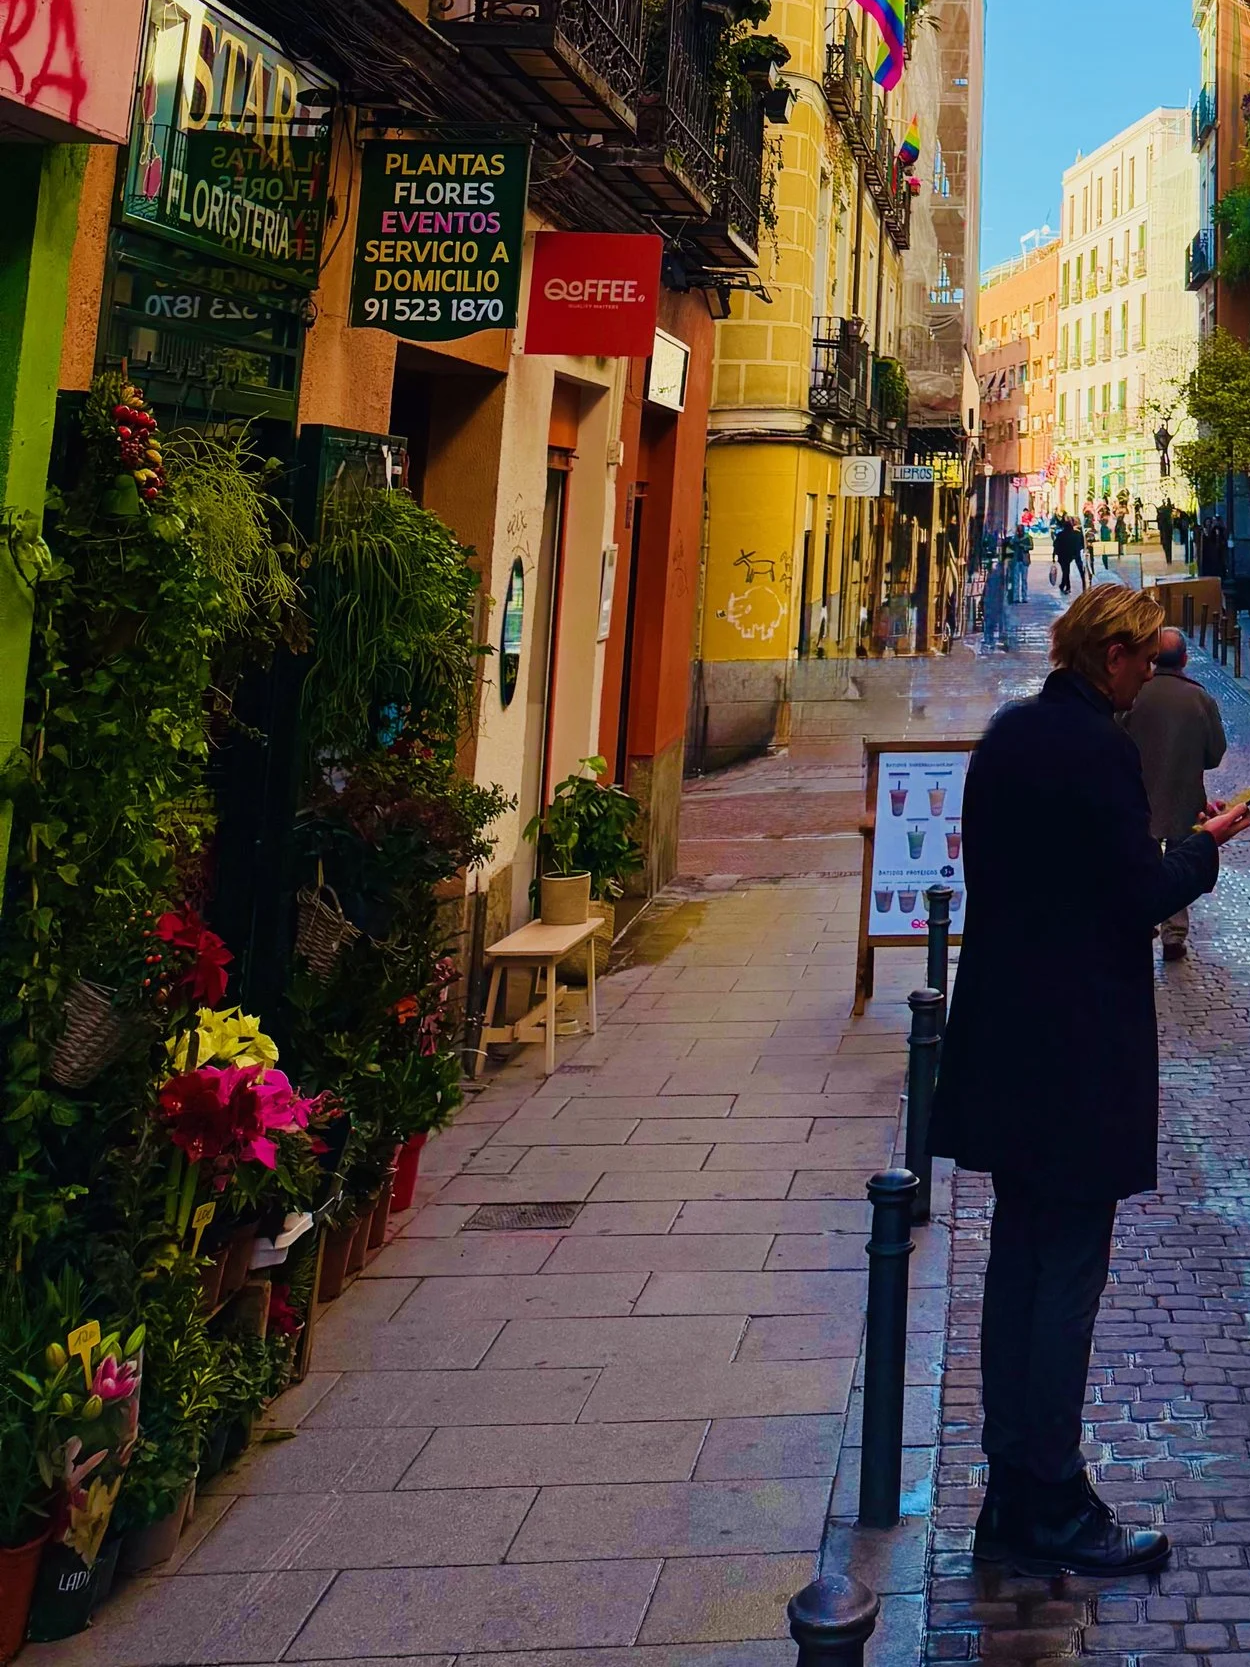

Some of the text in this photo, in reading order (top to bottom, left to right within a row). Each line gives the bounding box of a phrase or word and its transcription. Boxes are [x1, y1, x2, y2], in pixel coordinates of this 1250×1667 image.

[181, 21, 298, 171] STAR
[385, 153, 506, 176] PLANTAS
[394, 182, 495, 205] FLORES
[165, 168, 289, 260] FLORISTERÍA
[381, 211, 501, 234] EVENTOS
[364, 240, 510, 263] SERVICIO A
[374, 269, 500, 292] DOMICILIO
[364, 298, 504, 322] 91 523 1870
[893, 467, 933, 480] LIBROS
